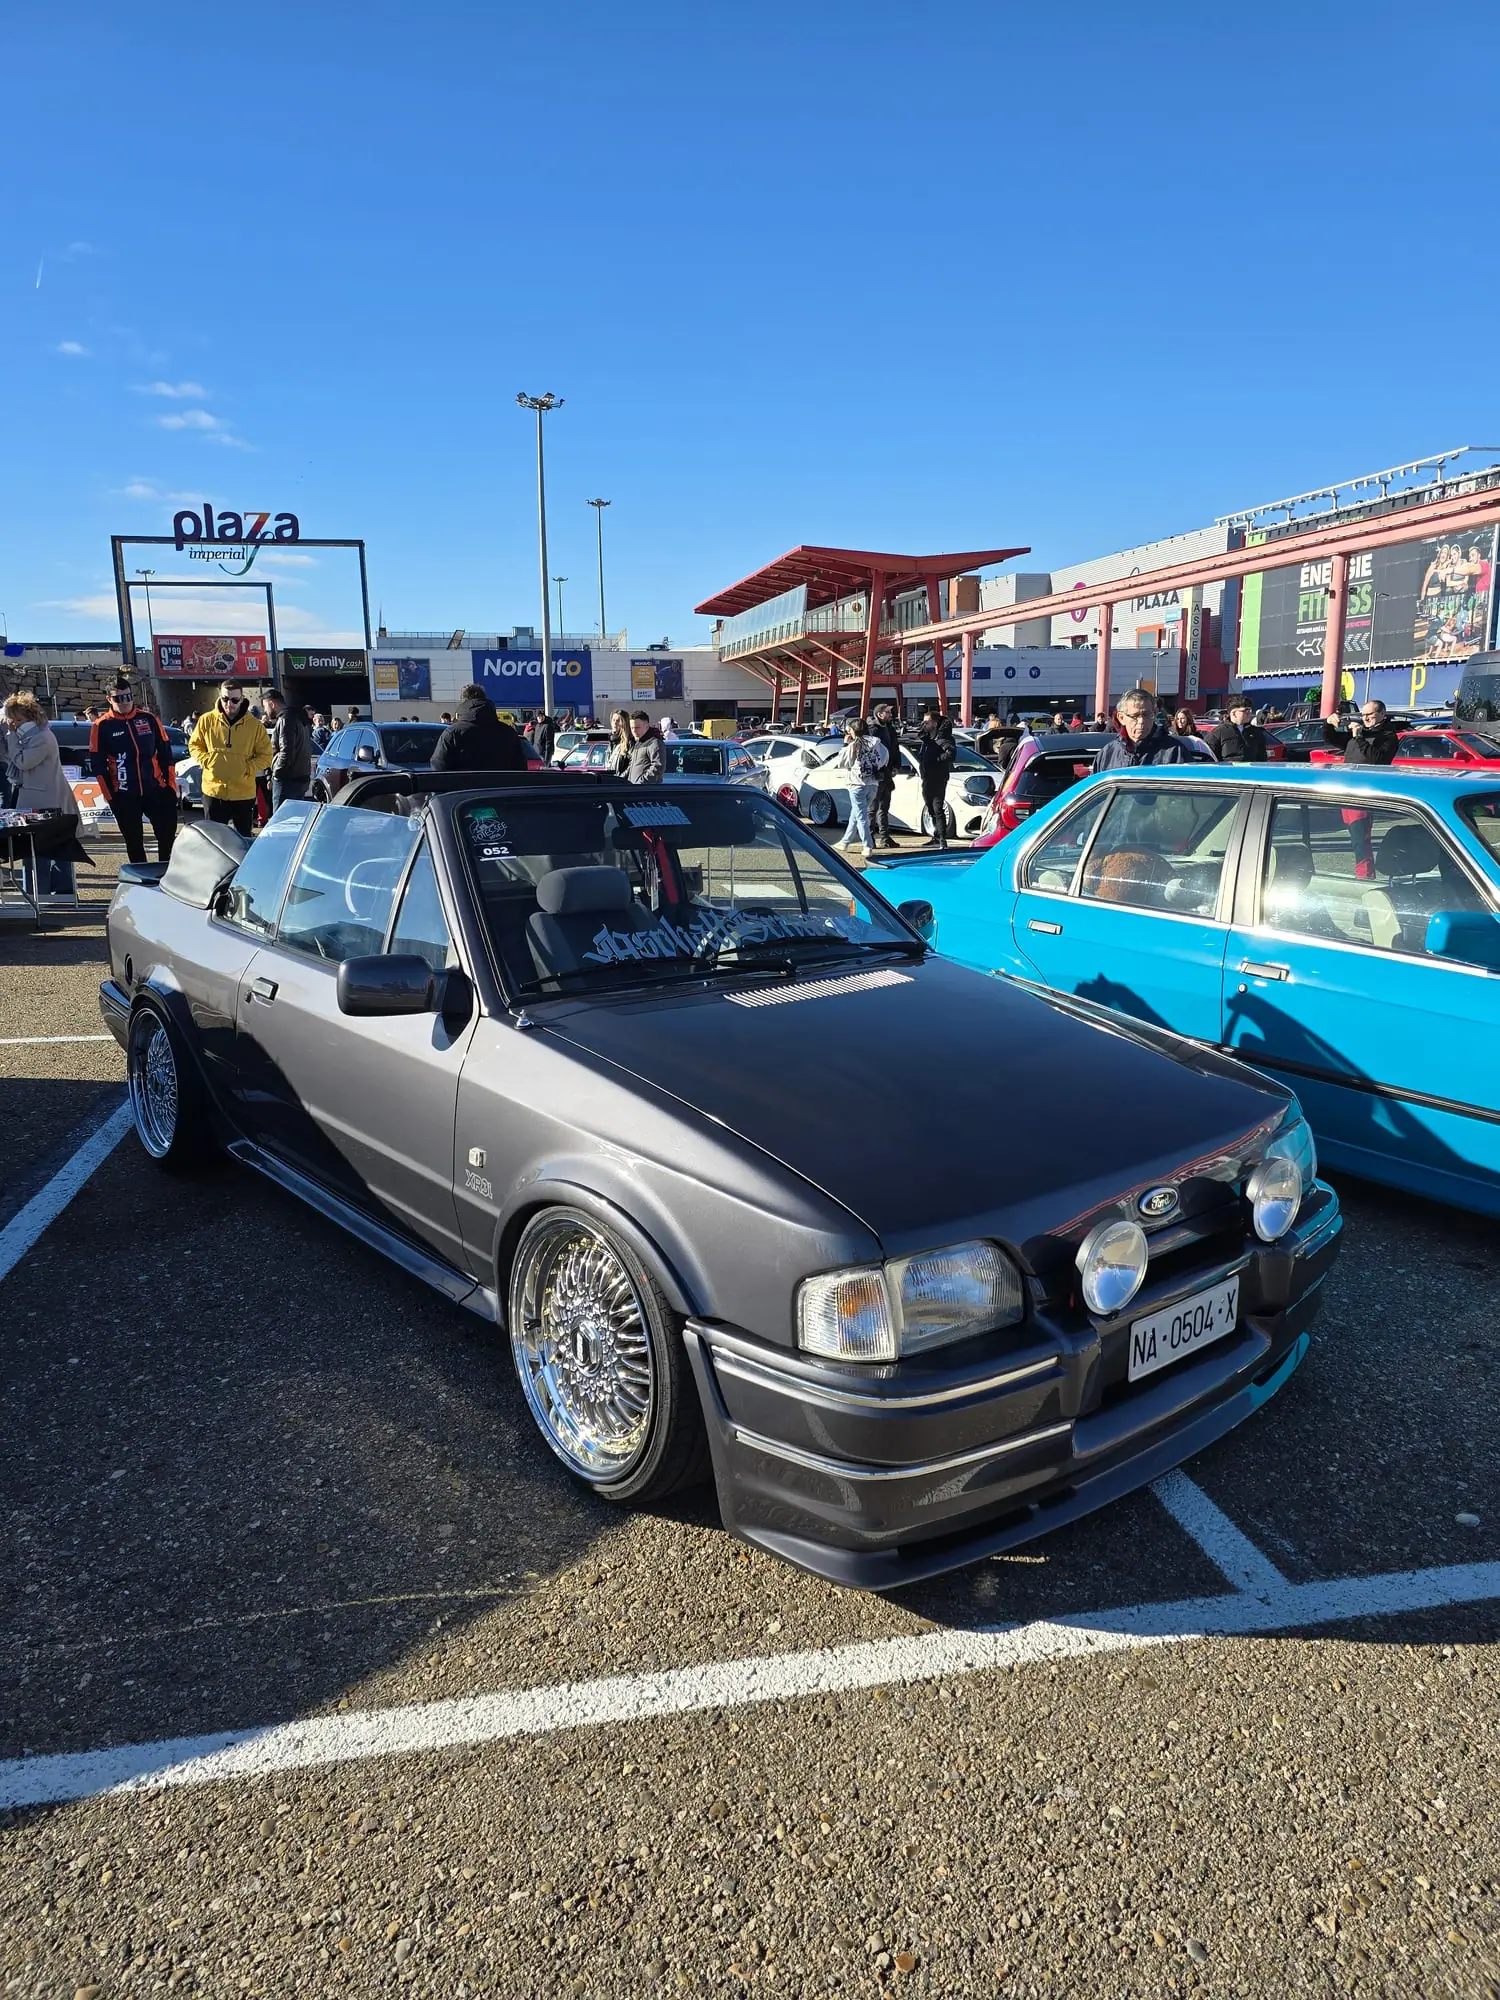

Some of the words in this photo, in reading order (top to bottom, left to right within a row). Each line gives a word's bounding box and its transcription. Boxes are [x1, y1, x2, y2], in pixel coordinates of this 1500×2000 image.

[173, 503, 300, 555] plaza
[188, 547, 246, 563] imperial
[1299, 553, 1373, 588] ÉNEGIE
[1298, 583, 1373, 622] FITSS
[308, 655, 346, 669] family
[346, 659, 363, 668] cash
[1188, 603, 1202, 699] ASCENSOR
[483, 846, 510, 856] 052
[1151, 1193, 1170, 1210] Ford
